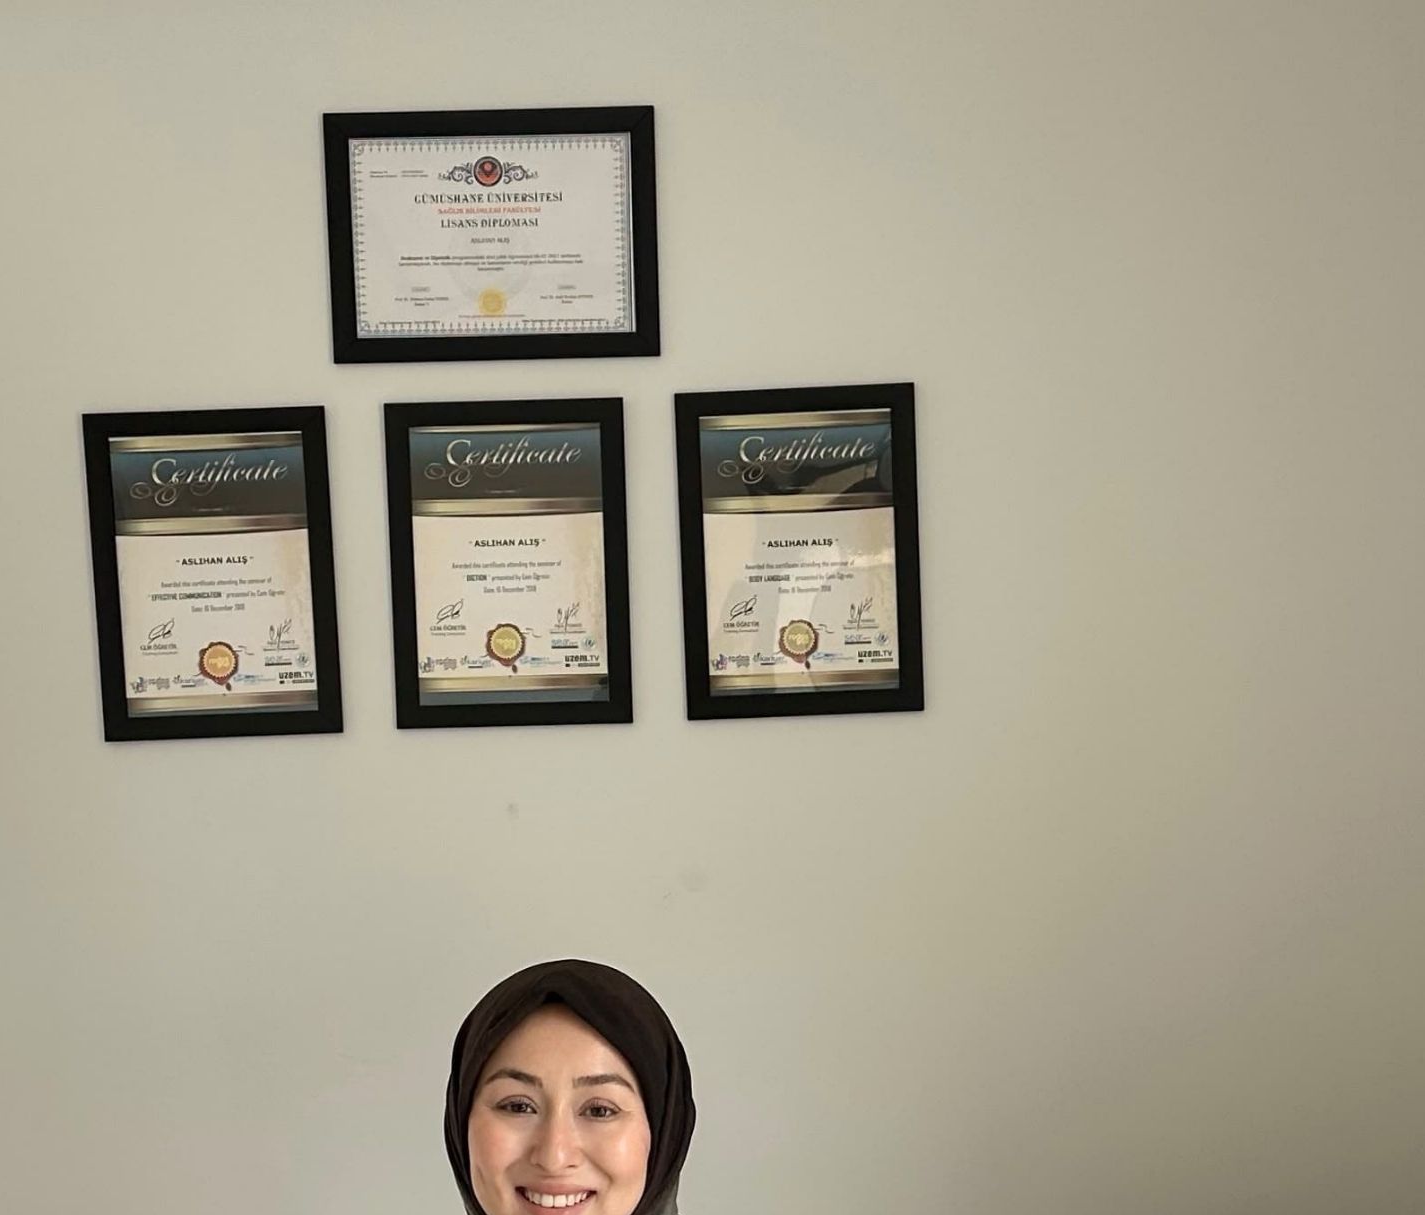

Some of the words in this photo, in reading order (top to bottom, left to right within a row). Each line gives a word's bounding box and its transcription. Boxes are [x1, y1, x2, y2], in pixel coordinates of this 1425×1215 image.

[487, 192, 563, 203] ÜNİVERSİTESİ
[441, 218, 478, 228] LİSANS
[425, 435, 581, 487] Certificate
[718, 431, 875, 484] Certificate
[130, 453, 288, 507] Certificate
[474, 539, 515, 547] ASLIHAN
[518, 538, 539, 547] ALIŞ
[767, 539, 808, 548] ASLIHAN
[811, 539, 833, 547] ALIŞ
[182, 557, 223, 566] ASLIHAN
[226, 556, 248, 565] ALIŞ
